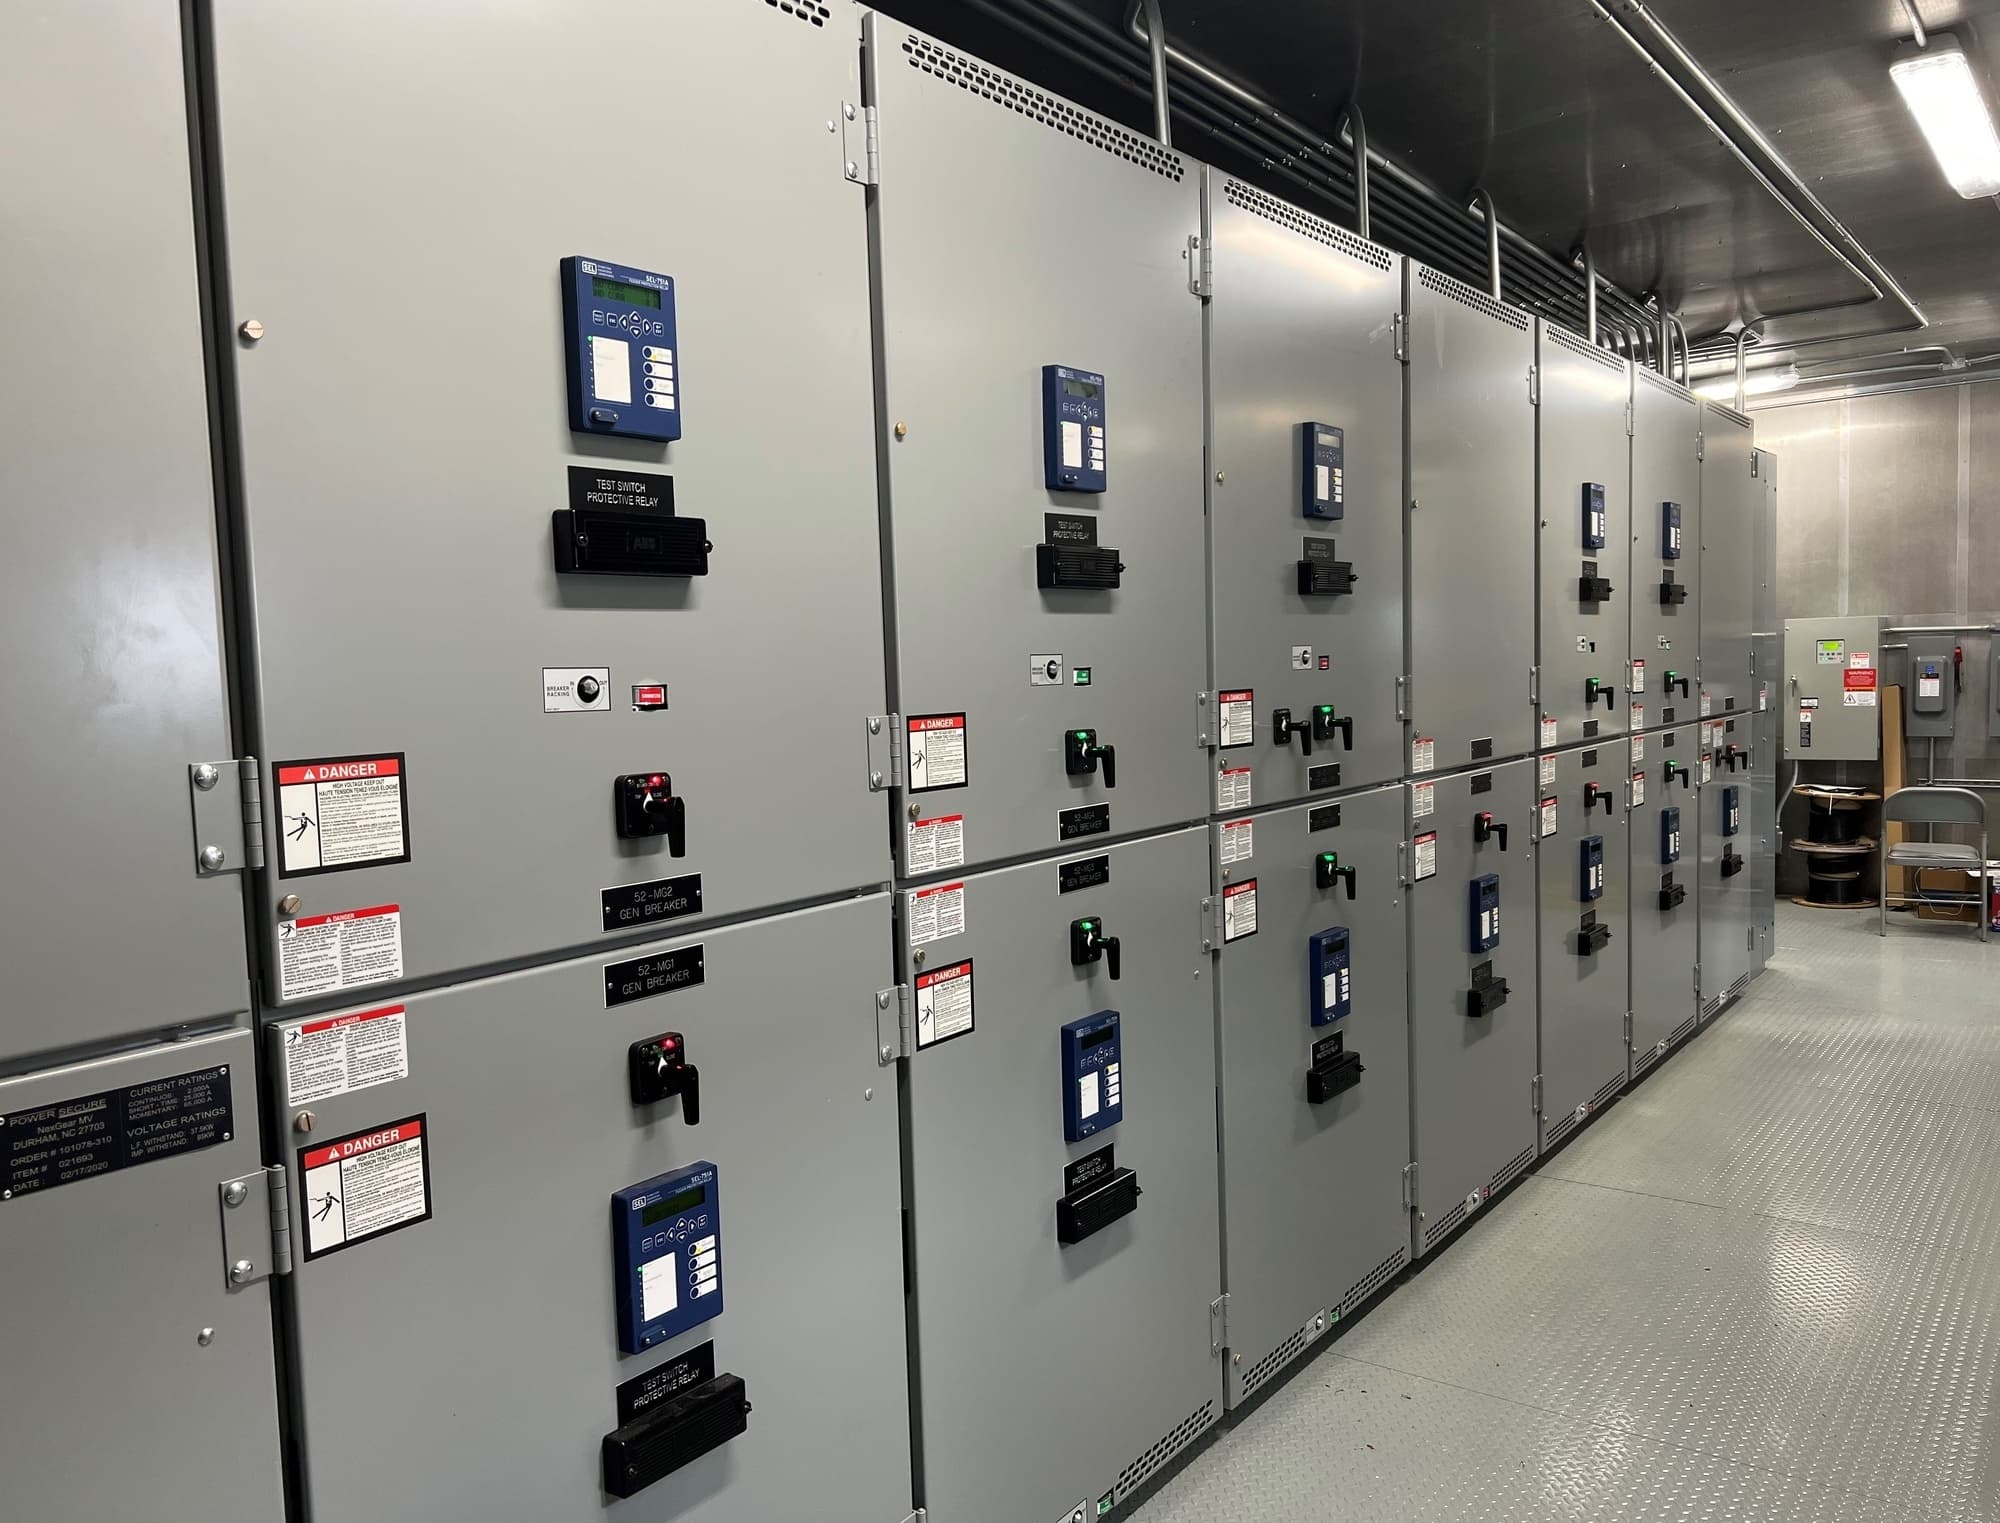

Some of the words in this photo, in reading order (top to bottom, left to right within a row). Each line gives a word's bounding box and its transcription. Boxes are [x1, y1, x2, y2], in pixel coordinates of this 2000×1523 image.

[596, 478, 616, 491] TEST
[617, 481, 646, 493] SWITCH
[587, 492, 634, 506] PROTECTIVE
[636, 496, 659, 507] RELAY
[927, 718, 954, 729] DANGER
[319, 763, 377, 779] DANGER
[634, 886, 673, 903] 52-MG2
[620, 907, 640, 920] GEN
[645, 897, 688, 916] BREAKER
[638, 958, 674, 976] 52-MG1
[934, 967, 961, 982] DANGER
[622, 982, 642, 995] GEN
[647, 969, 690, 989] BREAKER
[129, 1080, 176, 1098] CURRENT
[178, 1071, 218, 1087] RATINGS
[9, 1110, 55, 1128] POWER
[59, 1098, 107, 1117] SECURE
[128, 1103, 155, 1115] SHORT
[78, 1114, 94, 1126] MV
[127, 1118, 178, 1138] VOLTAGE
[180, 1106, 226, 1125] RATINGS
[13, 1133, 60, 1152] DURHAM,
[62, 1129, 77, 1139] NC
[344, 1129, 400, 1156] DANGER
[10, 1151, 49, 1167] ORDER
[12, 1167, 39, 1180] ITEM
[13, 1179, 40, 1192] DATE
[60, 1161, 109, 1180] 02/17/2020
[642, 1375, 661, 1392] TEST
[662, 1362, 689, 1382] SWITCH
[633, 1378, 678, 1410] PROTECTIVE
[678, 1367, 701, 1387] RELAY
